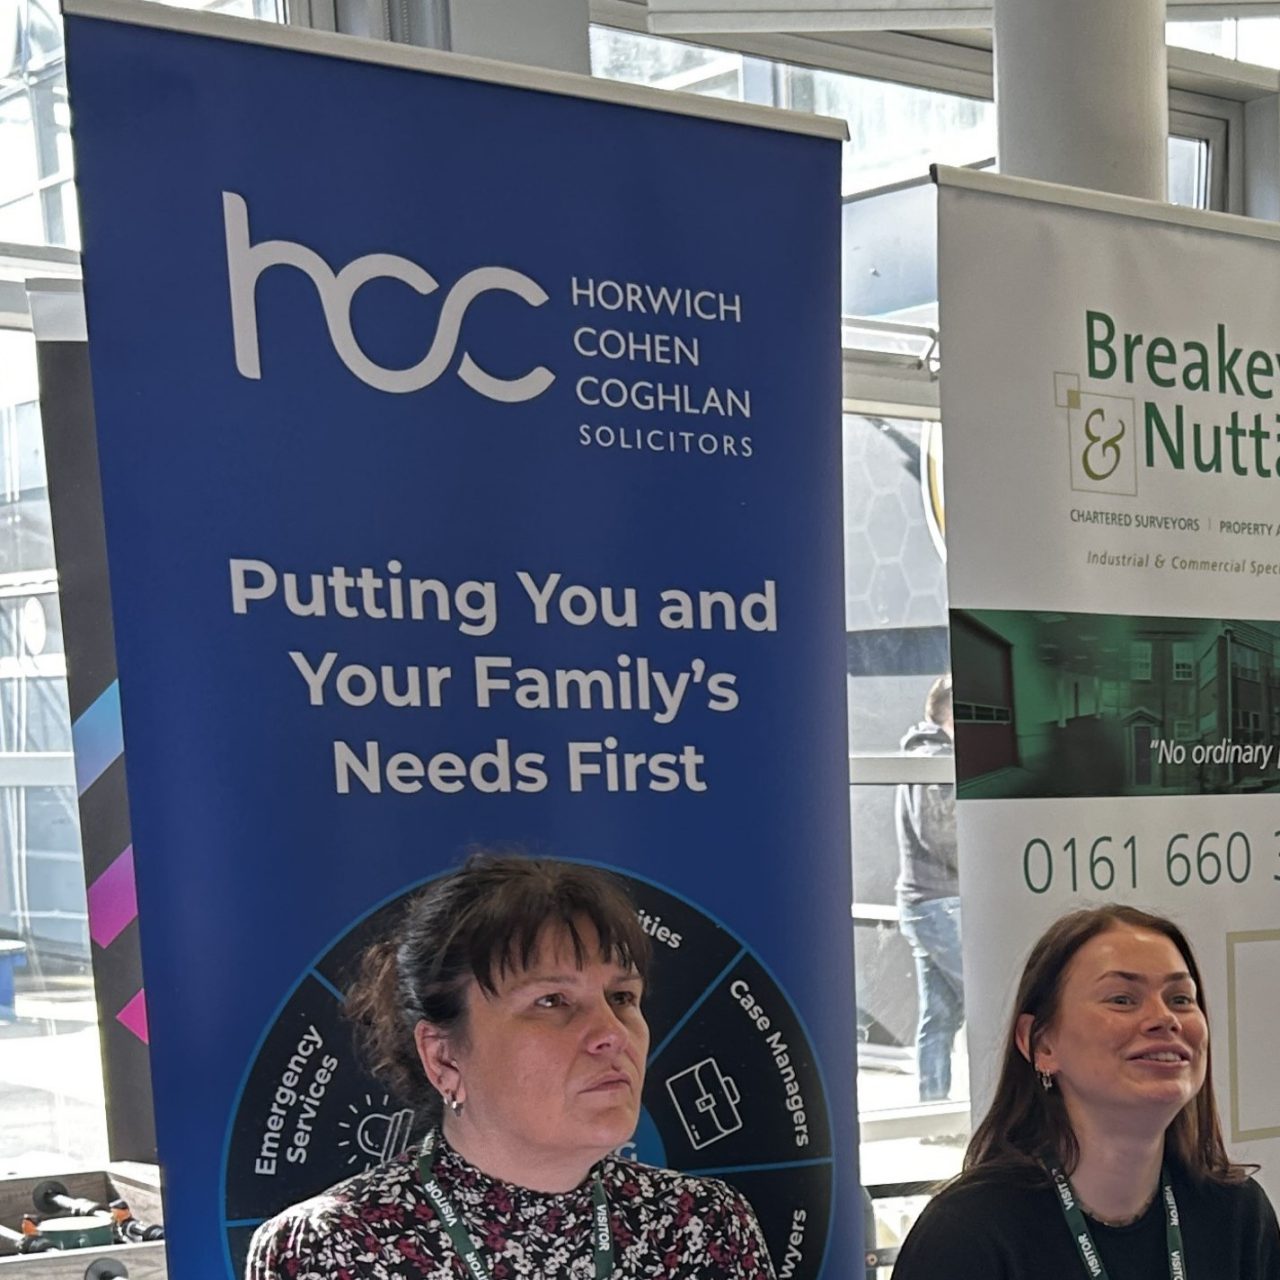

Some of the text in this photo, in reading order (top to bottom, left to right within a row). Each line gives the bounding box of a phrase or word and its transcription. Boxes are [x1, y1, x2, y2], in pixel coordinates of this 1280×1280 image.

[222, 191, 556, 402] hcc
[571, 276, 742, 323] HORWICH
[573, 326, 699, 367] COHEN
[576, 376, 751, 418] COGHLAN
[579, 424, 753, 457] SOLICITORS
[1082, 408, 1125, 480] &
[1070, 509, 1132, 527] CHARTERED
[1135, 514, 1200, 531] SURVEYORS
[1219, 520, 1273, 536] PROPERTY
[1087, 551, 1149, 567] Industrial
[1154, 554, 1165, 568] &
[1171, 556, 1246, 573] Commercial
[229, 558, 778, 636] Putting You and
[289, 651, 739, 724] Your Family’s
[333, 737, 708, 794] Needs First
[1150, 739, 1186, 764] “No
[1192, 739, 1272, 769] ordinary
[1023, 835, 1137, 894] 0161
[1166, 831, 1251, 887] 660
[729, 980, 809, 1147] Case Managers
[254, 1025, 323, 1175] Emergency
[286, 1055, 338, 1164] Services
[424, 1180, 458, 1227] VISITOR
[1164, 1185, 1179, 1227] VISITOR
[596, 1204, 610, 1251] VISITOR
[1078, 1233, 1102, 1277] VISITOR
